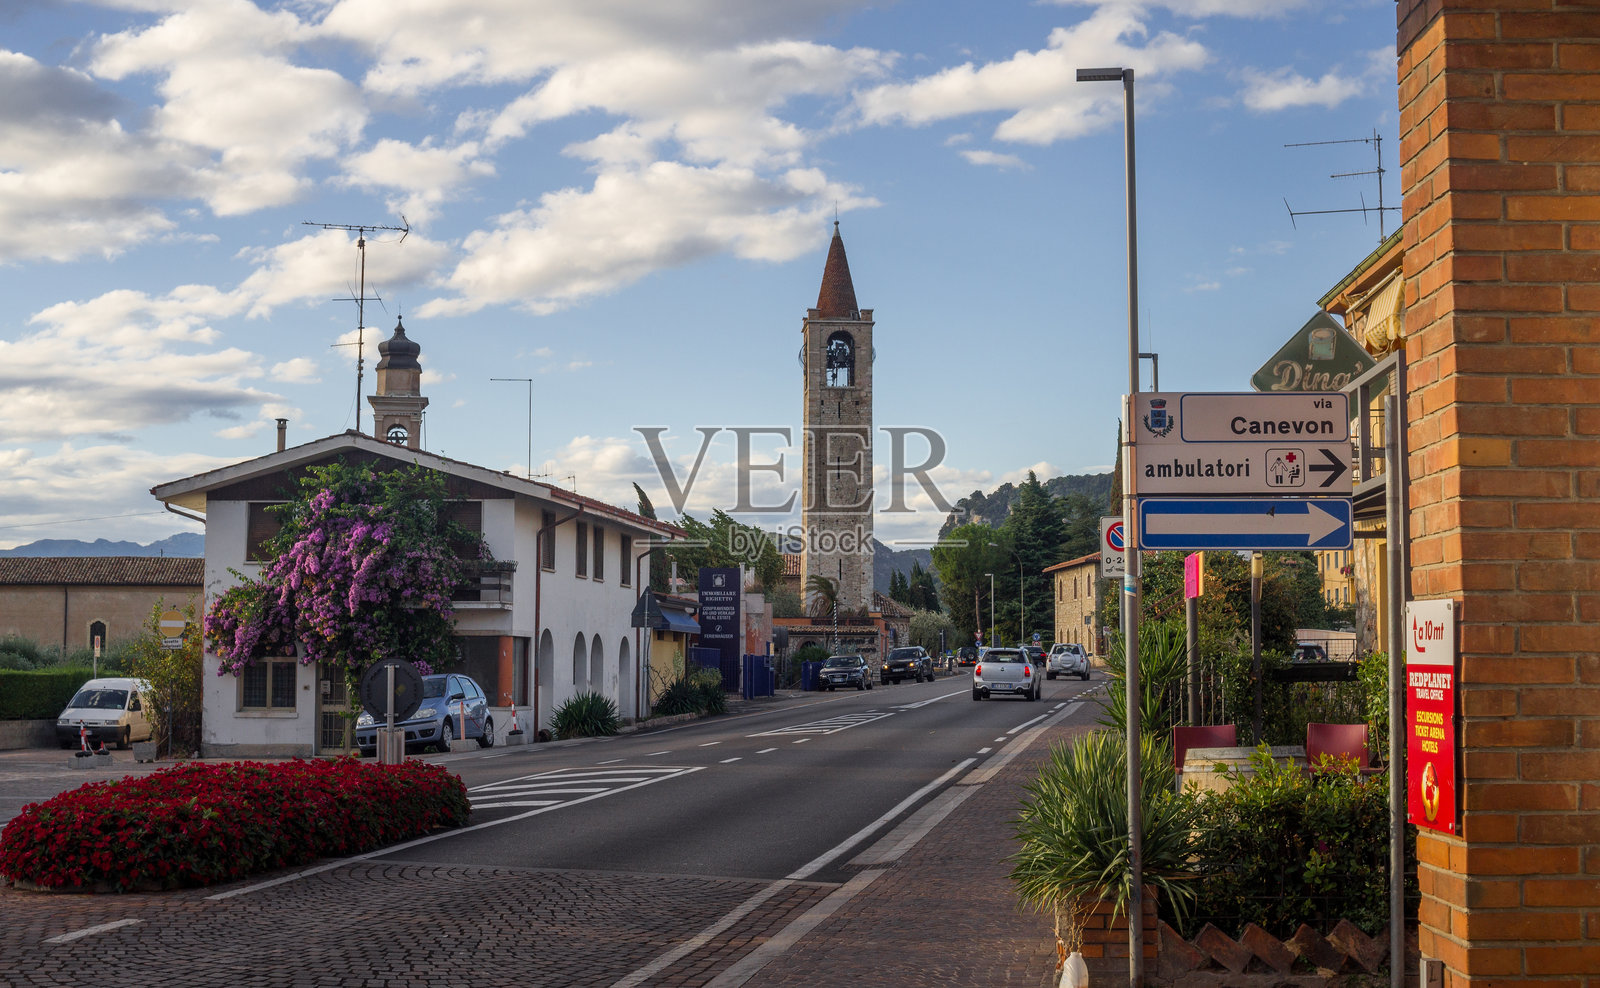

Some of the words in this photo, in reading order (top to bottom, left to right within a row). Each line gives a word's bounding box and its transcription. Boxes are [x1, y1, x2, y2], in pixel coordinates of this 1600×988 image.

[1313, 398, 1333, 409] via
[1230, 416, 1334, 435] Canevon
[1145, 458, 1250, 478] ambulatori
[1418, 626, 1424, 640] a
[1425, 620, 1433, 640] 10
[1433, 622, 1444, 640] mt
[1416, 688, 1430, 699] TRAVEL
[1430, 689, 1444, 701] OFFICE
[1416, 710, 1444, 726] ESCURSIONS
[1415, 724, 1429, 738] TICKET
[1430, 727, 1446, 740] ARENA
[1421, 740, 1438, 754] HOTELS
